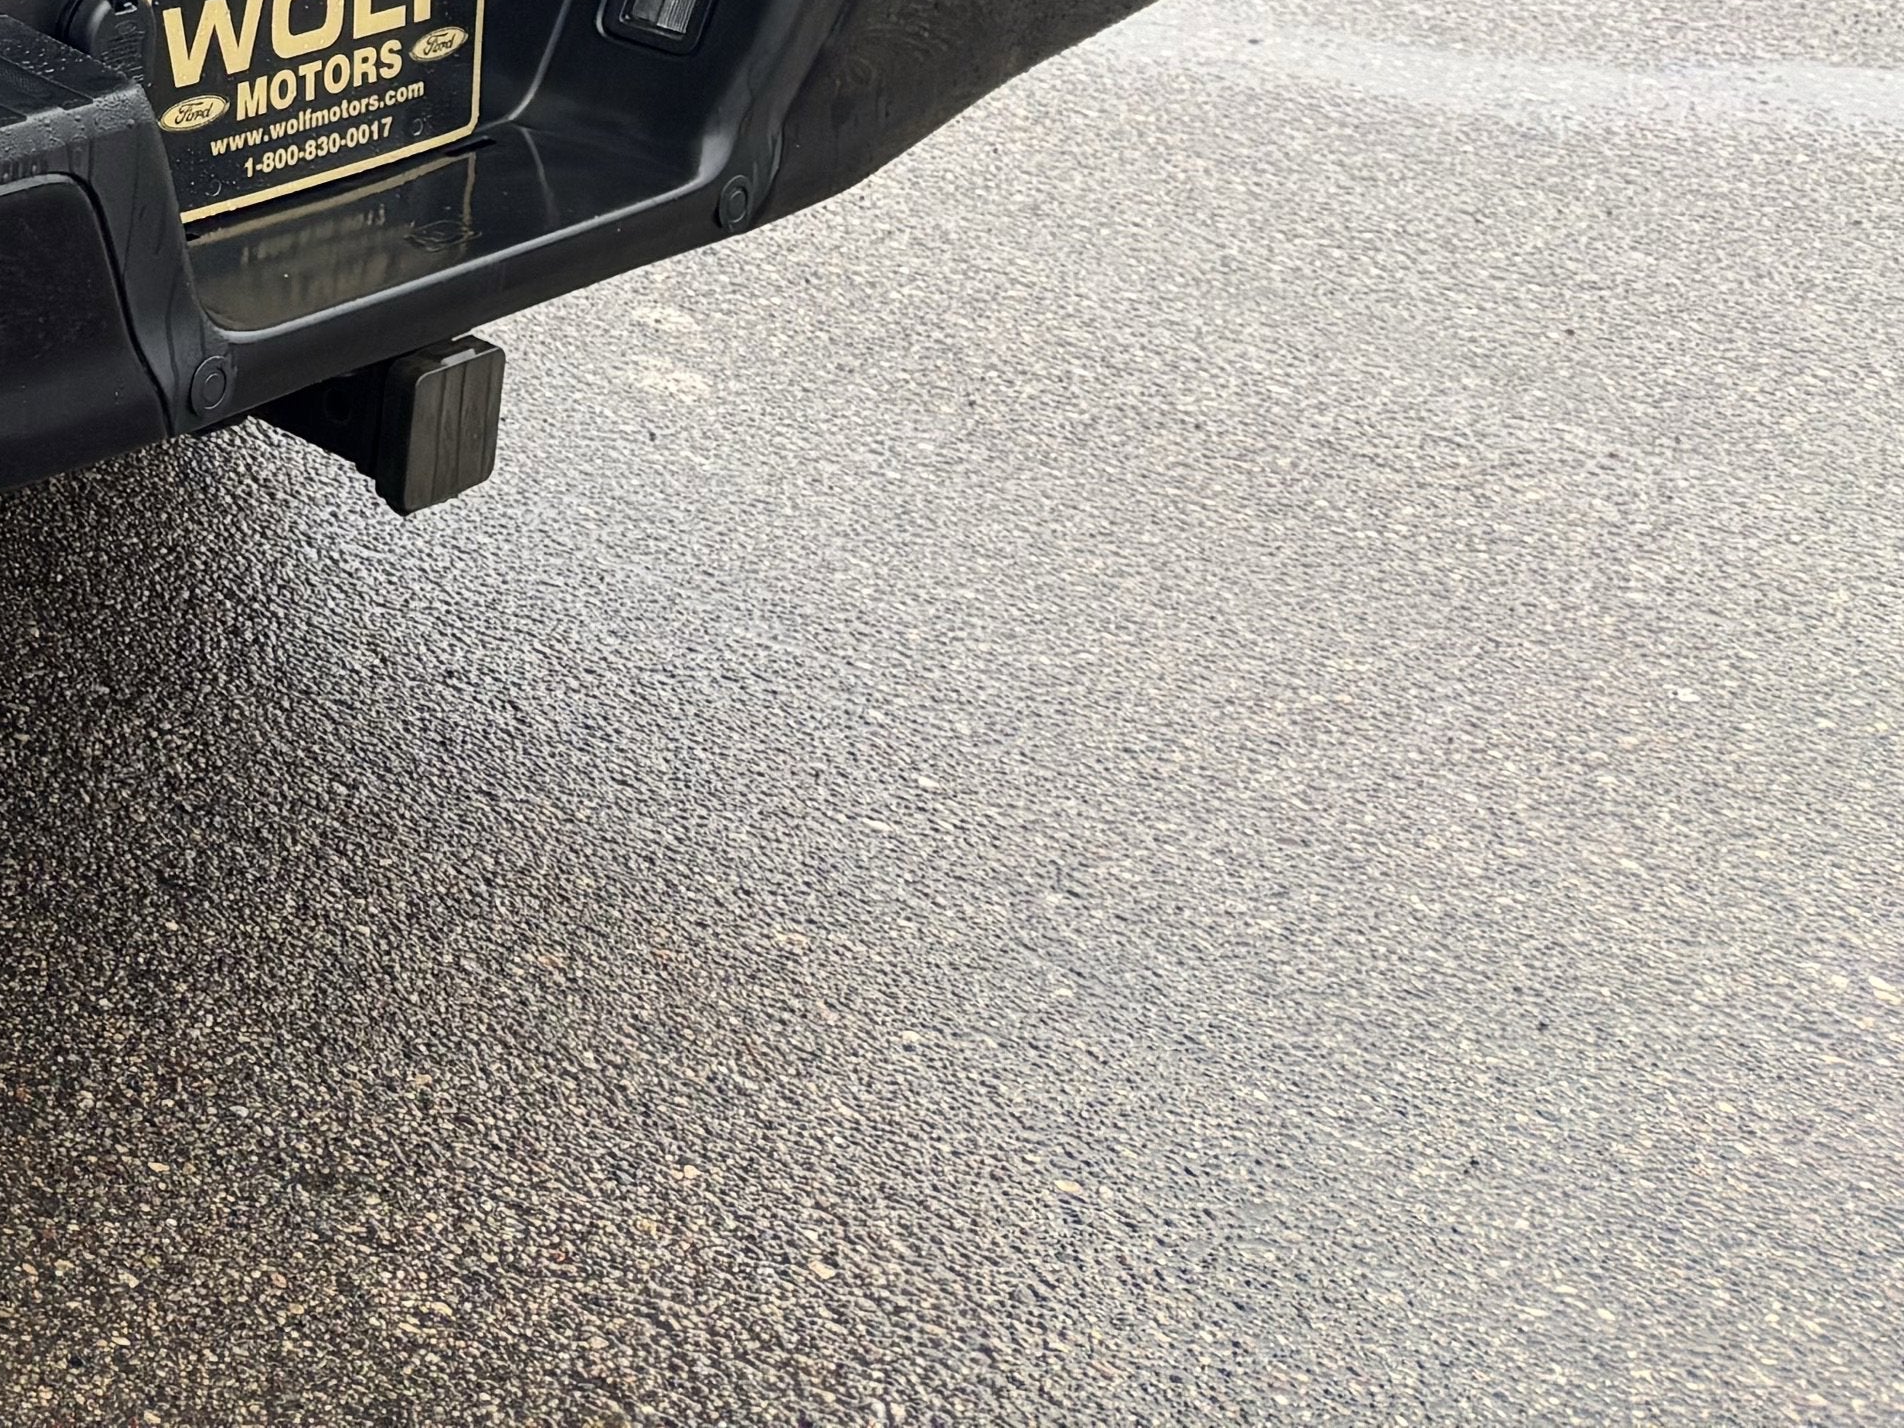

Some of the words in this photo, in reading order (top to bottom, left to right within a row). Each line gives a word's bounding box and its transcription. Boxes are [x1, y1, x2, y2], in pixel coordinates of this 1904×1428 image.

[422, 33, 455, 56] Ford
[236, 38, 403, 122] MOTORS
[174, 99, 214, 126] Ford
[210, 79, 425, 157] www.wolfmotors.com
[244, 116, 394, 179] 1-800-830-0017
